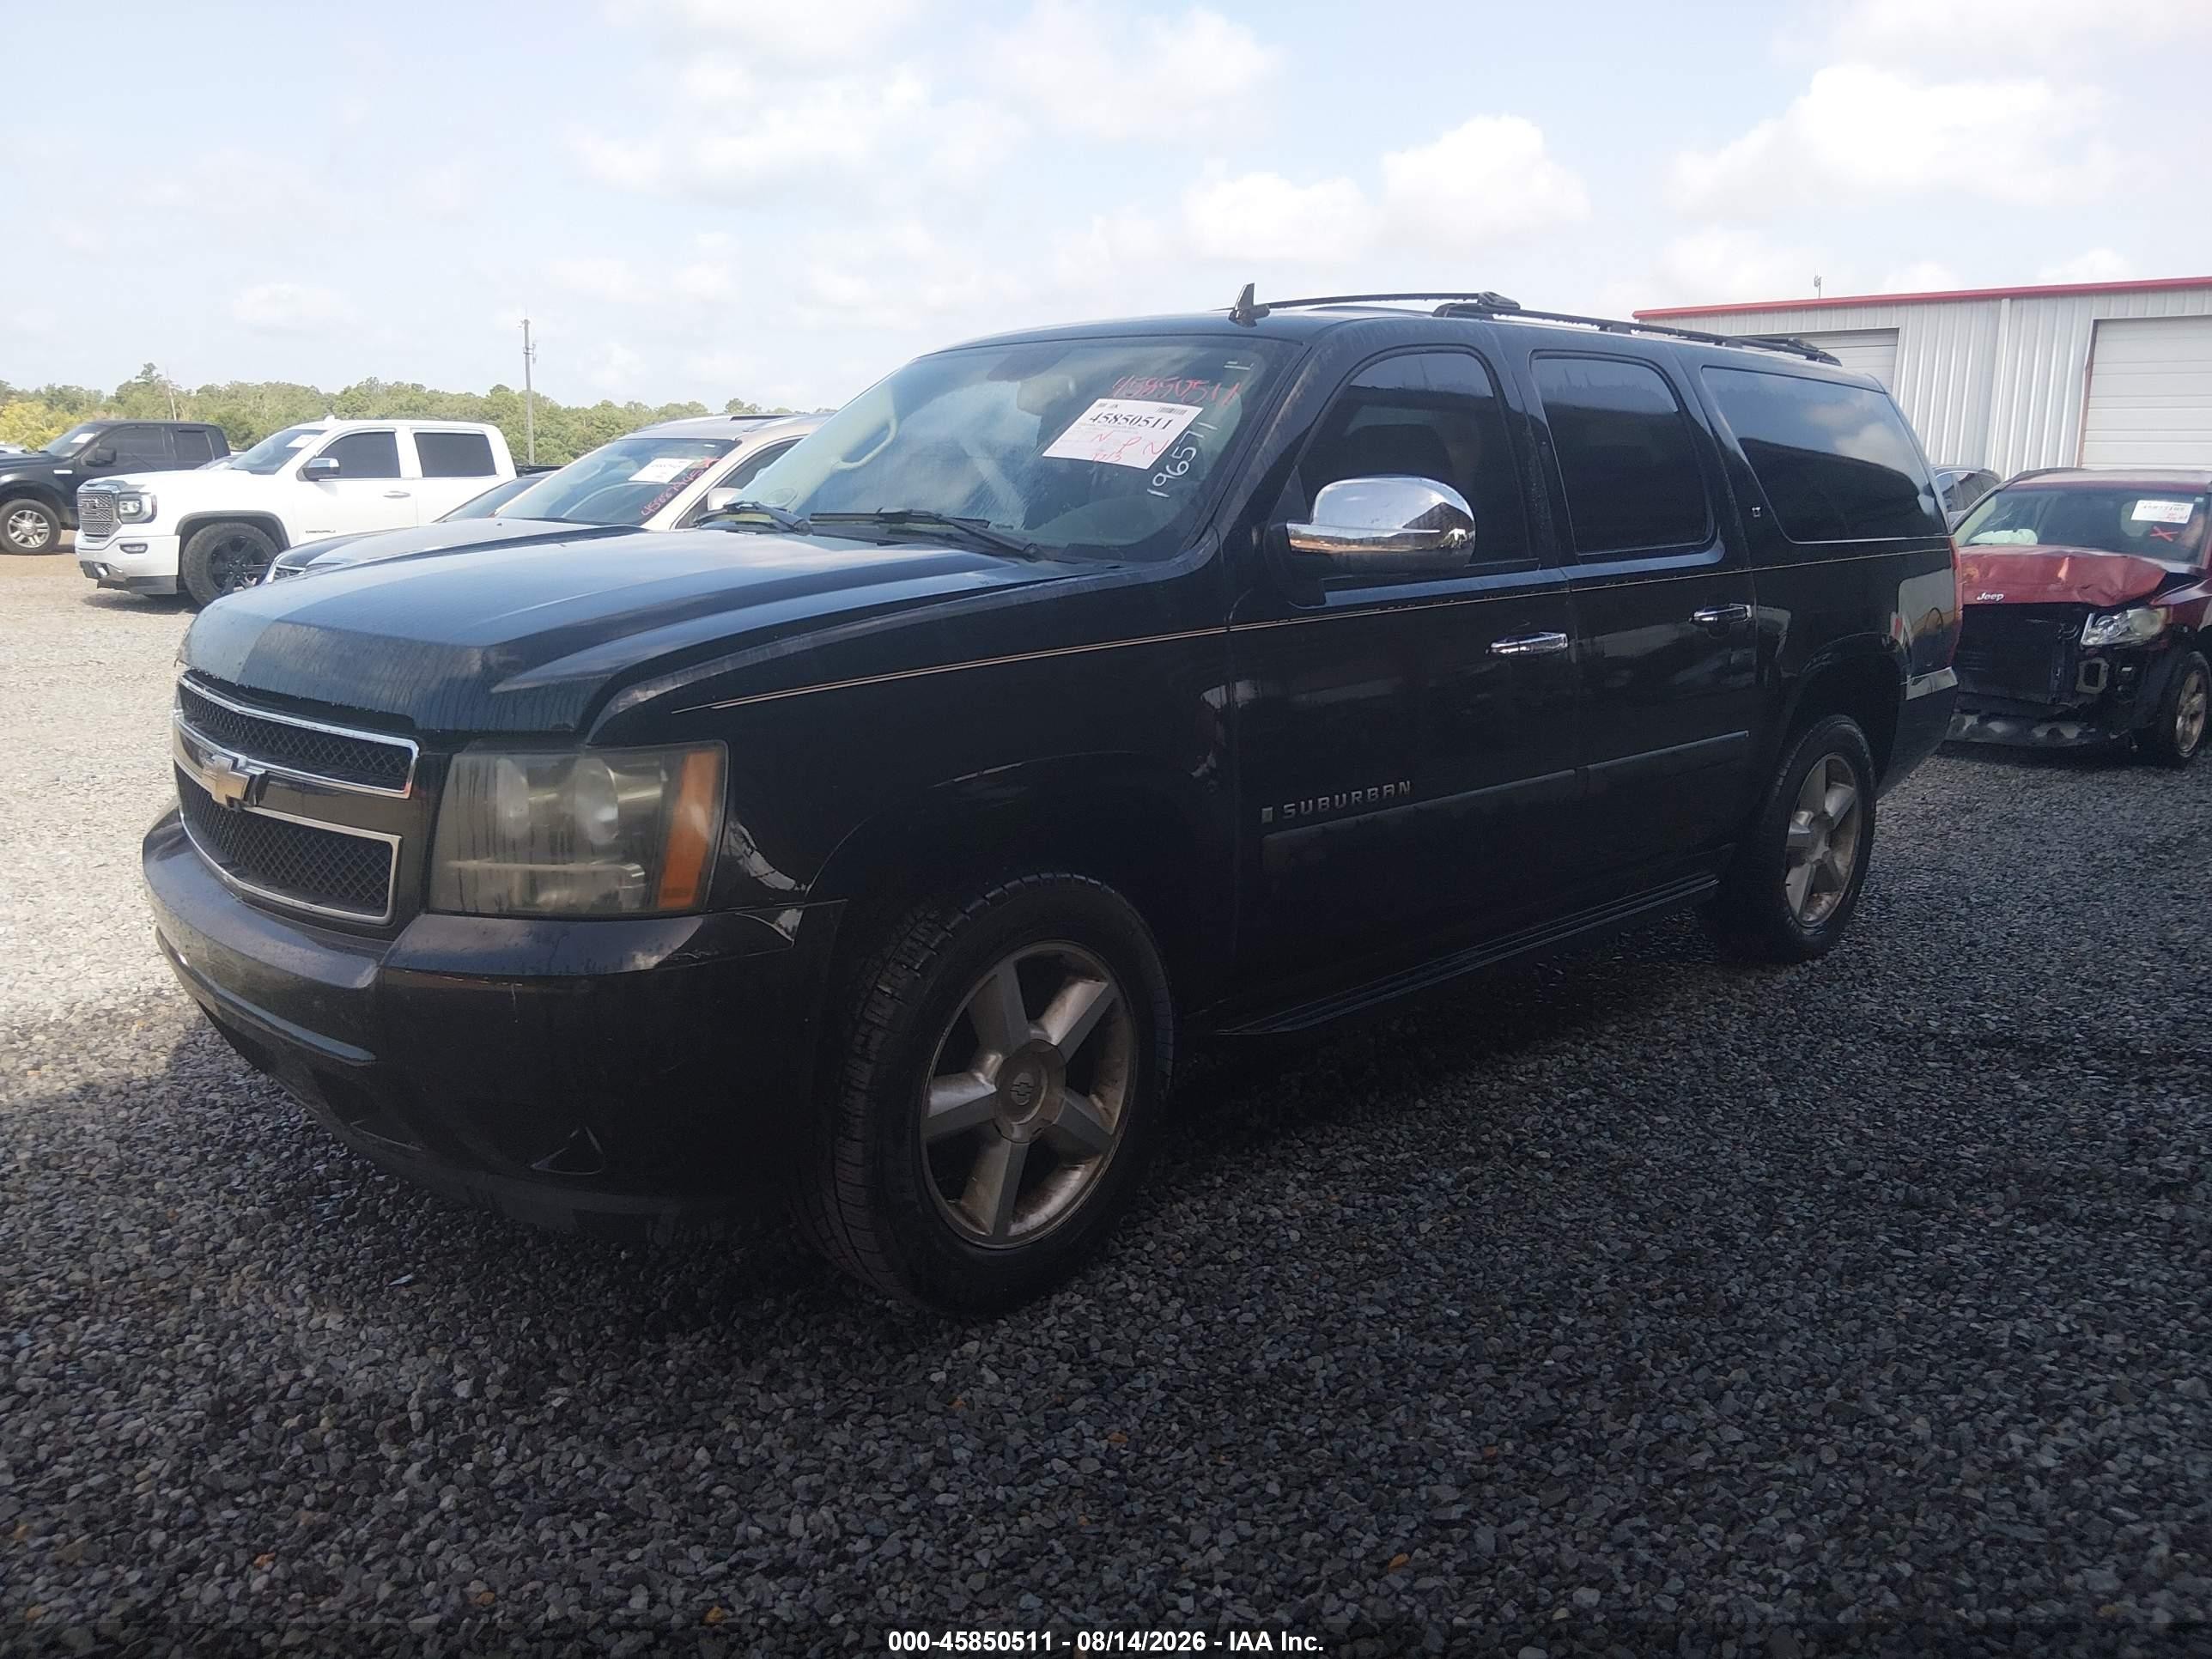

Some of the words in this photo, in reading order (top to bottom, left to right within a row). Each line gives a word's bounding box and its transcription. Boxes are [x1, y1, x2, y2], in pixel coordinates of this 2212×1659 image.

[1089, 411, 1174, 430] 45850511
[1146, 422, 1218, 498] 196571
[1977, 592, 2005, 602] Jeep
[1283, 780, 1412, 818] SUBURBAN
